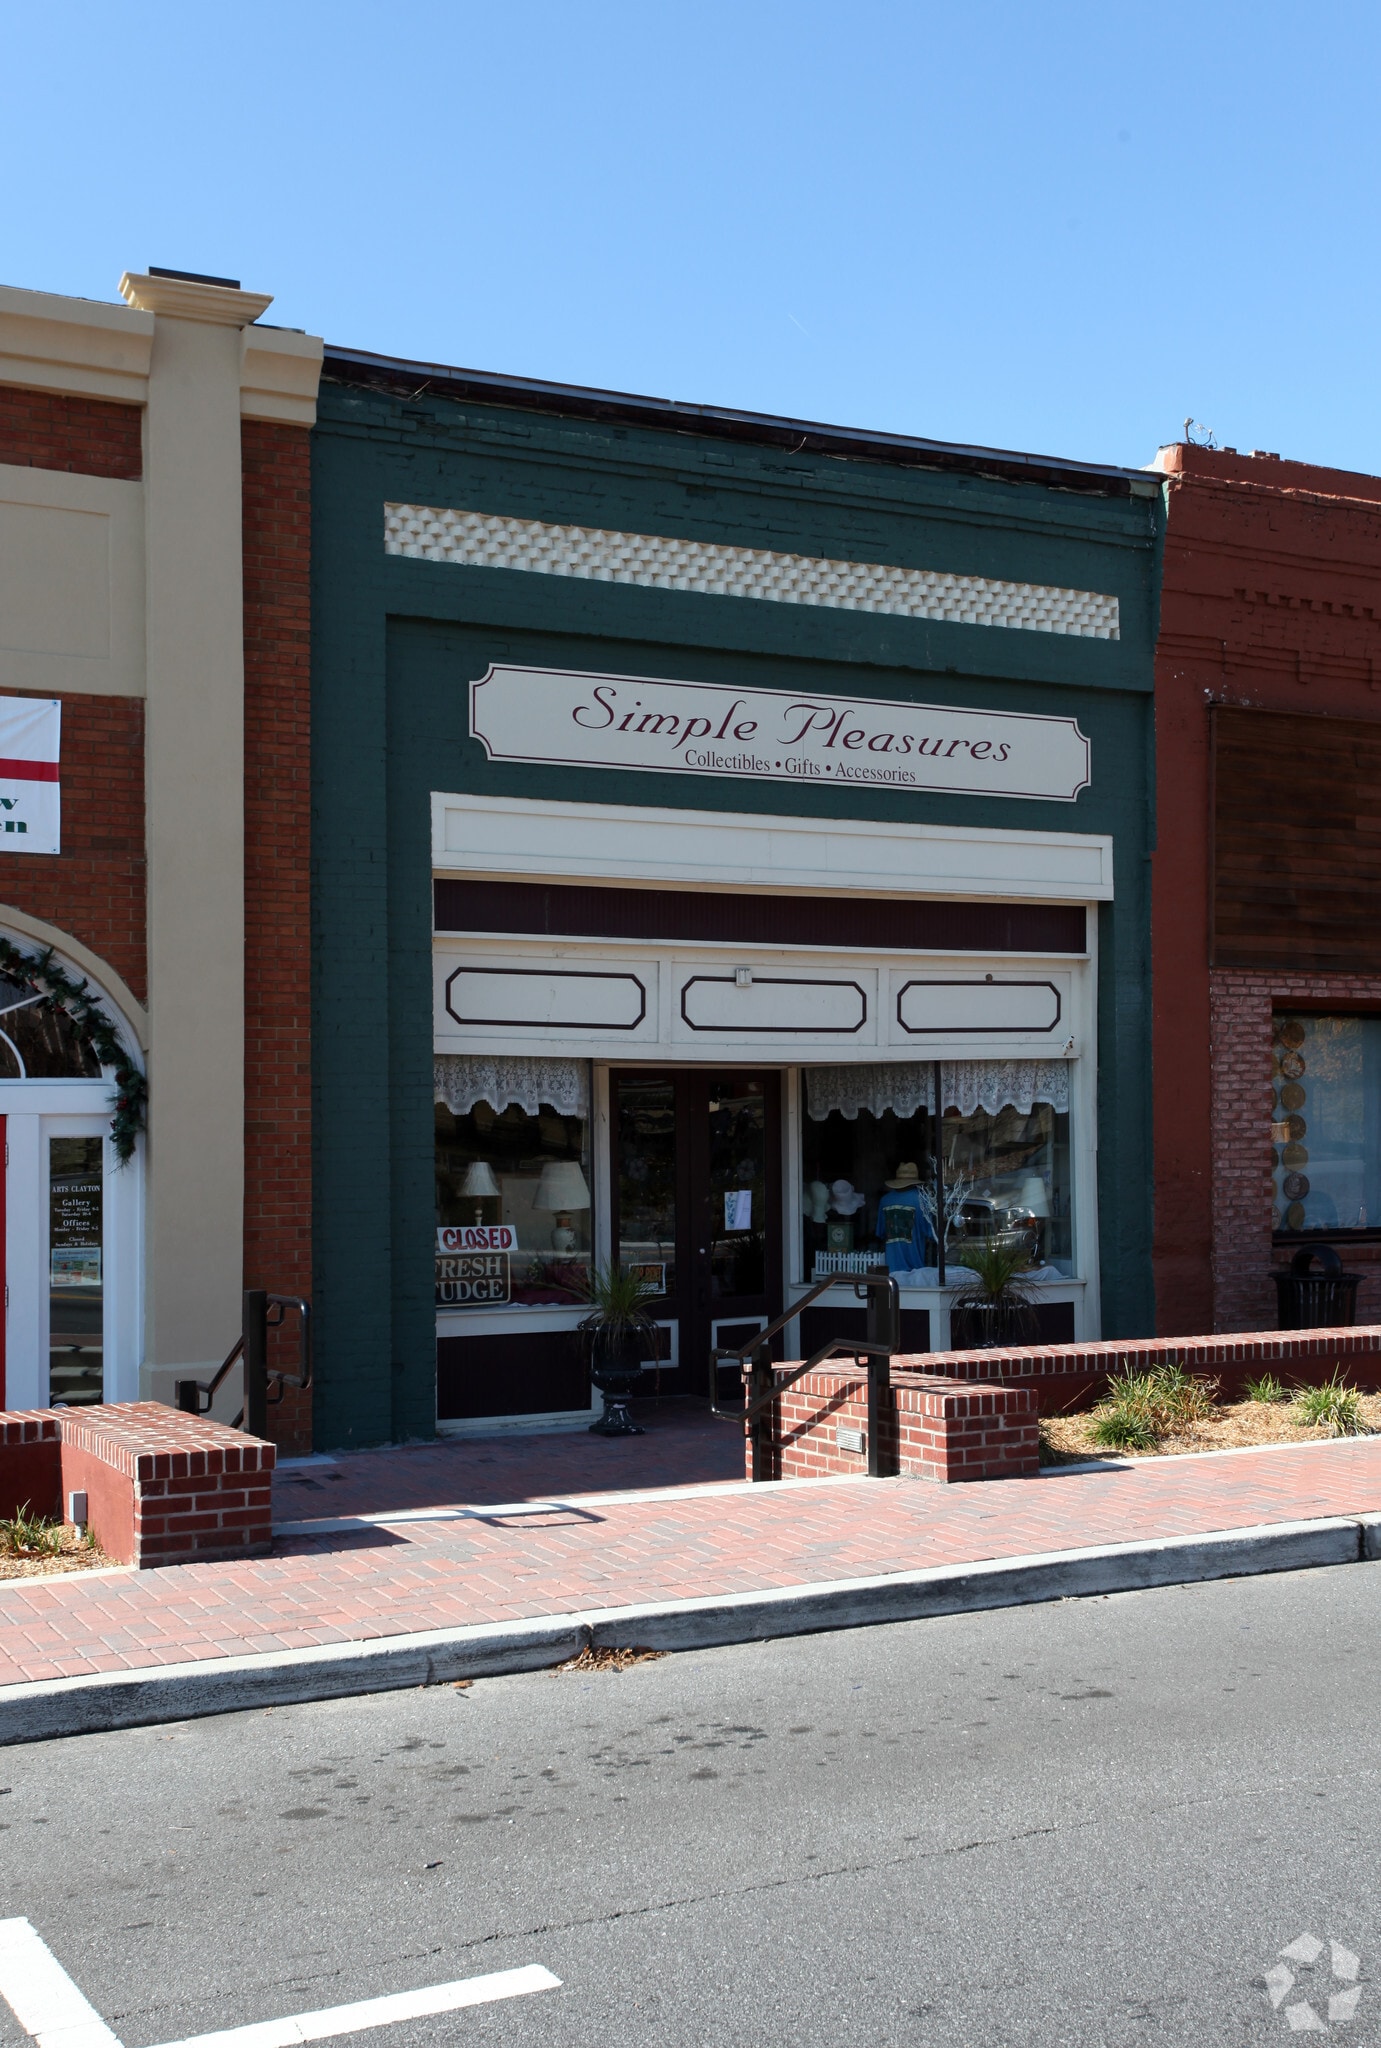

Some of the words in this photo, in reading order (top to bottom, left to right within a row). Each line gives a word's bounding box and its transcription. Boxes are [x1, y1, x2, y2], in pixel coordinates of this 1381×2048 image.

[572, 686, 759, 749] Simple
[776, 704, 1012, 762] Pleasures
[685, 749, 771, 773] Collectibles
[784, 757, 821, 776] Gifts
[835, 762, 917, 783] Accessories
[62, 1199, 90, 1207] Gallery
[443, 1227, 513, 1250] CLOSED
[435, 1278, 504, 1301] UDGE
